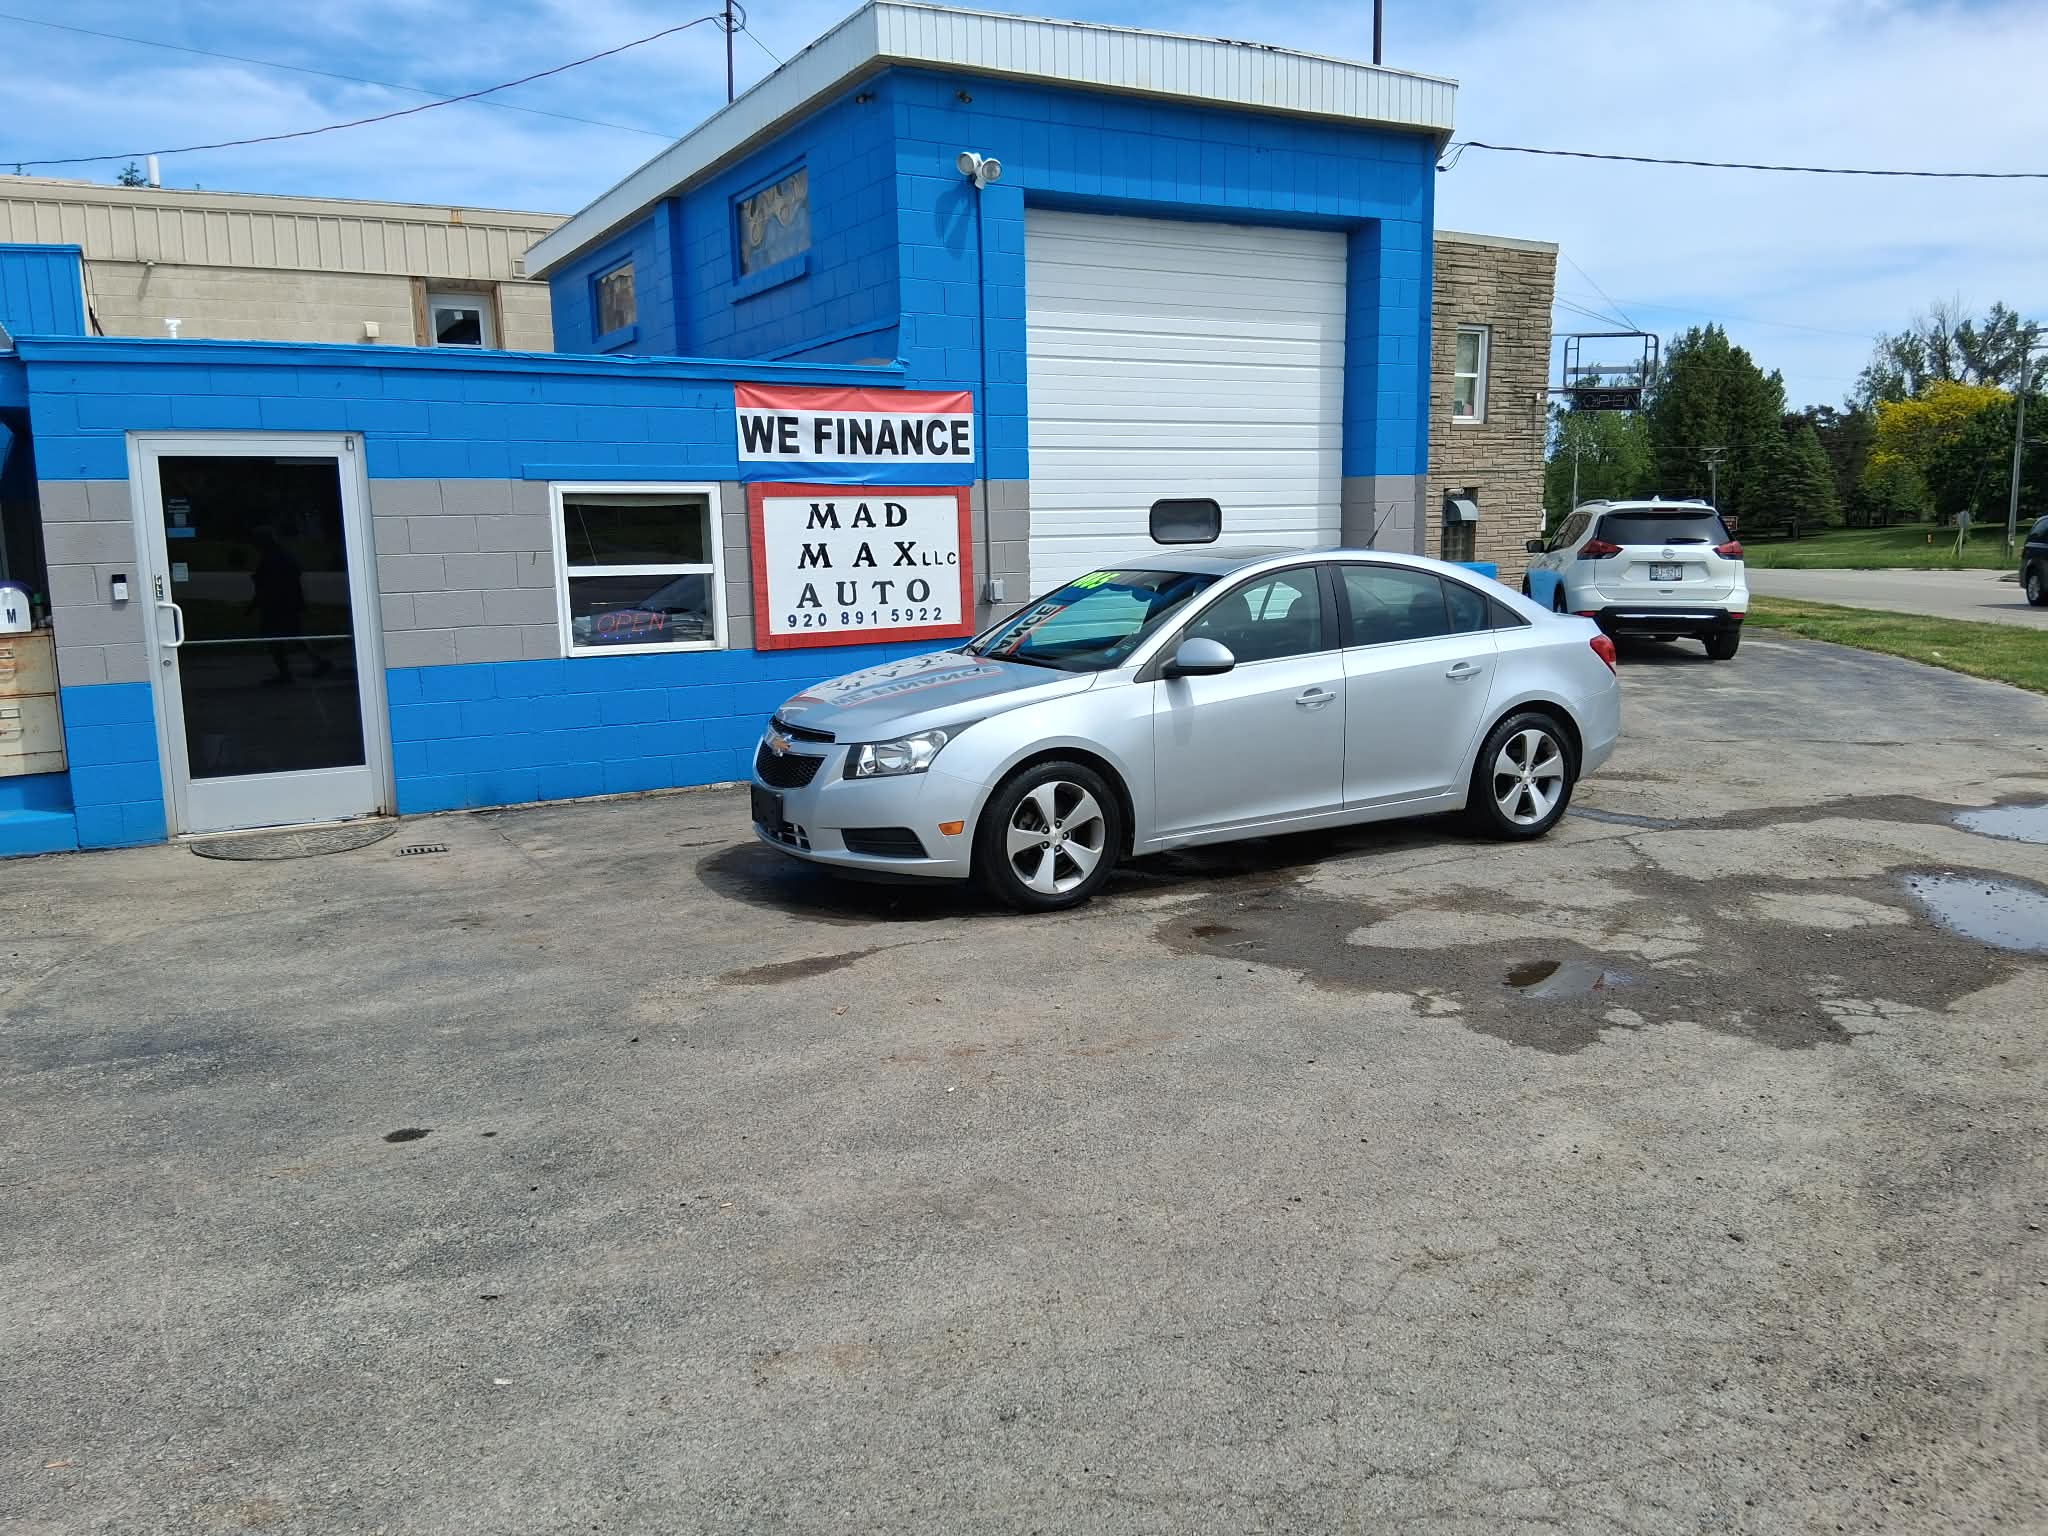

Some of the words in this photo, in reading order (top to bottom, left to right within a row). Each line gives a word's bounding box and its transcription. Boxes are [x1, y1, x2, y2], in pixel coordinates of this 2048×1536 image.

[740, 415, 800, 454] WE
[813, 417, 970, 456] FINANCE
[806, 502, 908, 530] MAD
[797, 541, 917, 570] MAX
[922, 551, 957, 566] LLC
[796, 578, 931, 609] AUTO
[6, 608, 17, 624] M
[597, 611, 667, 633] OPEN
[787, 612, 828, 628] 920
[840, 609, 878, 625] 891
[891, 606, 943, 622] 5922
